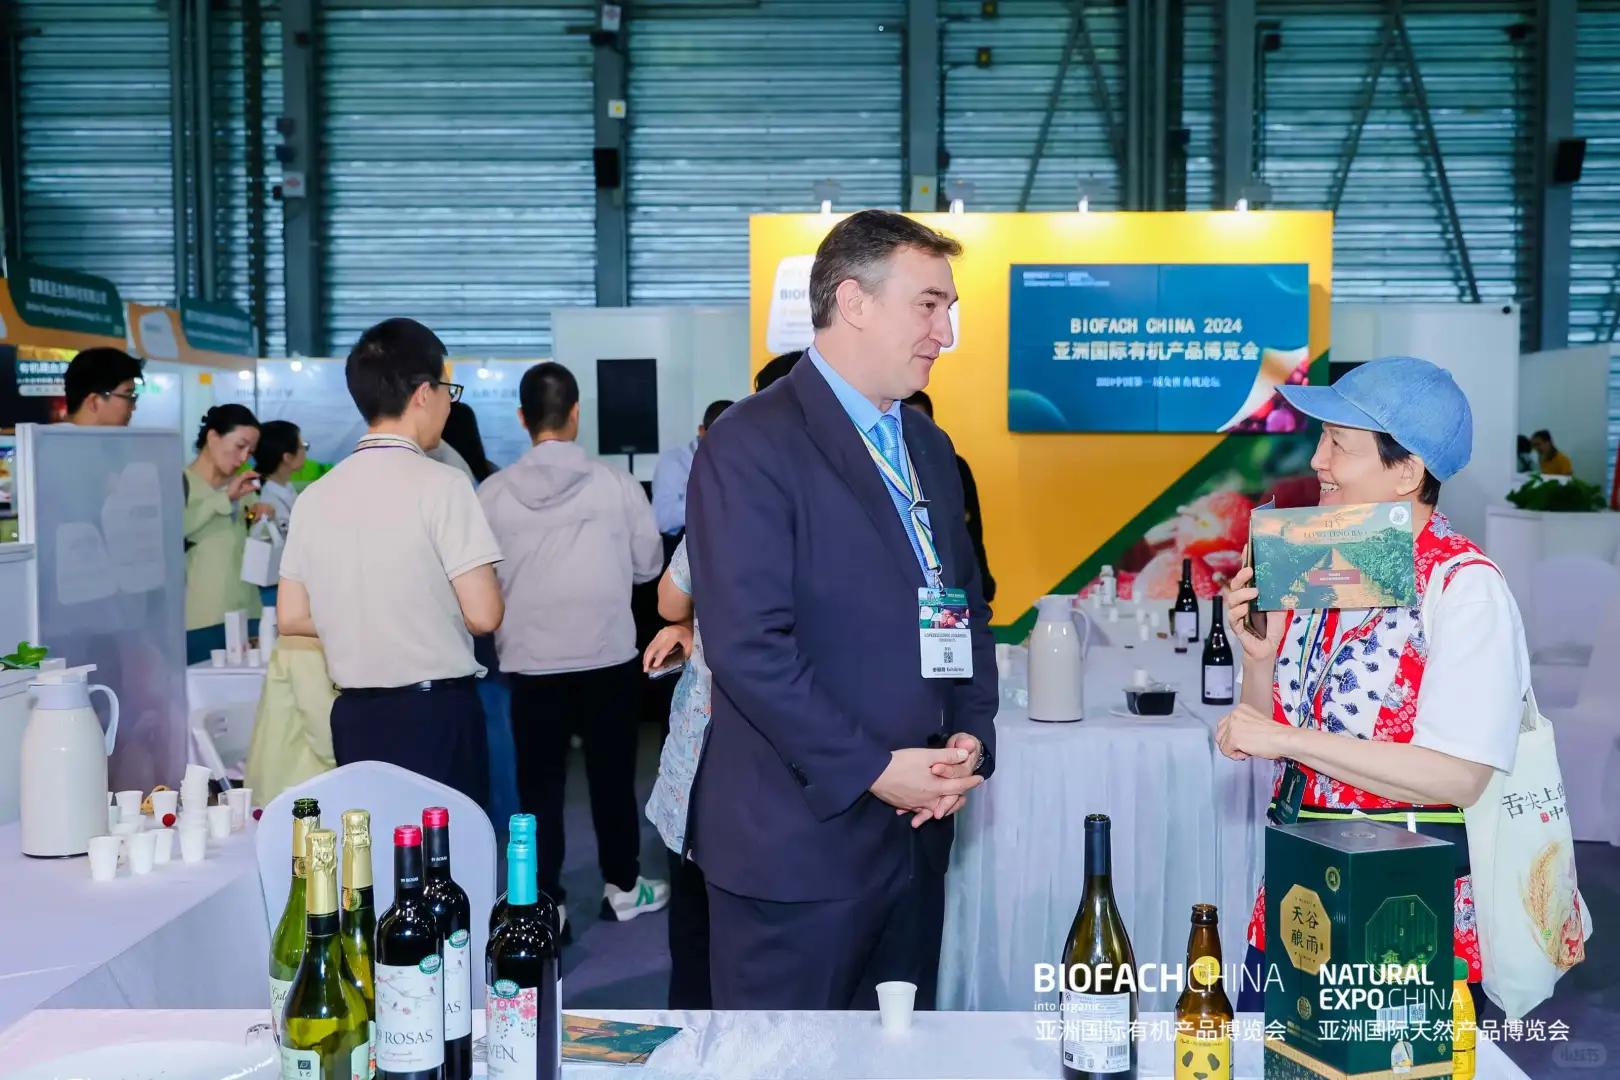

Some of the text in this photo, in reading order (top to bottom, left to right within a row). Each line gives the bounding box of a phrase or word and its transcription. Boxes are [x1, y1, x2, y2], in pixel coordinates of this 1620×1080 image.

[1070, 317, 1243, 334] BIOFACH CHINA 2024
[1052, 340, 1260, 361] 亚洲国际有机产品博览会
[384, 1029, 433, 1045] ROSAS
